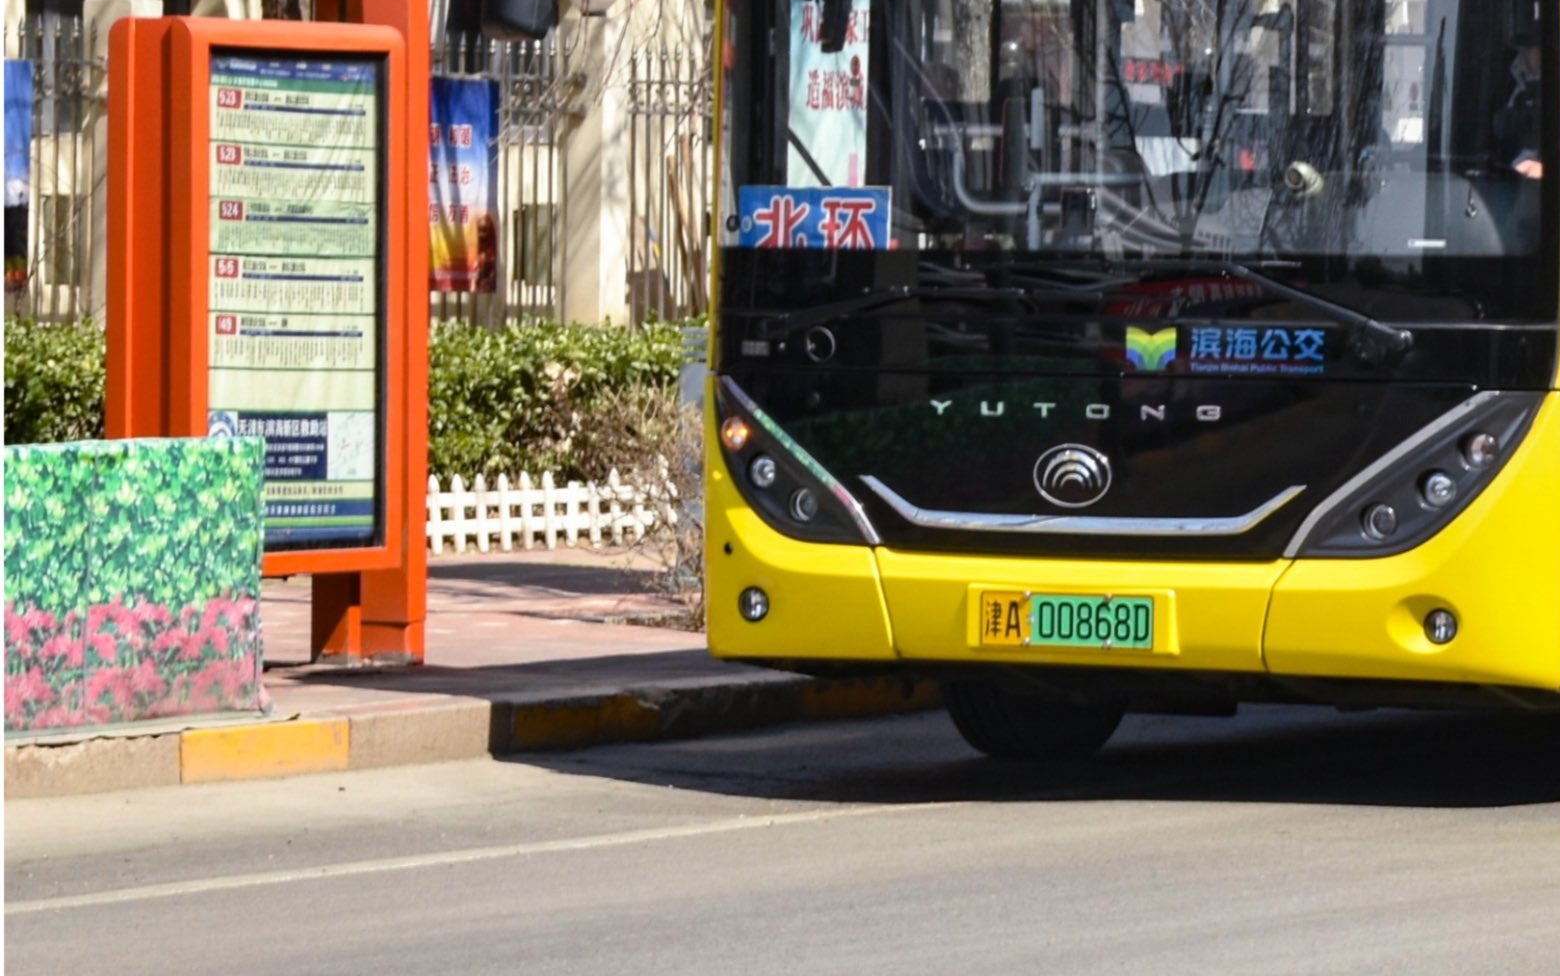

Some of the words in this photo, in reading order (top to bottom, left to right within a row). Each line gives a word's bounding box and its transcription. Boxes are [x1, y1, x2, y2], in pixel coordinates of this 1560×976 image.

[754, 195, 876, 248] 北环
[1190, 328, 1325, 360] 滨海公交
[930, 400, 1221, 420] YUTONG
[985, 600, 1022, 638] 津A
[1038, 601, 1150, 642] 00868D
